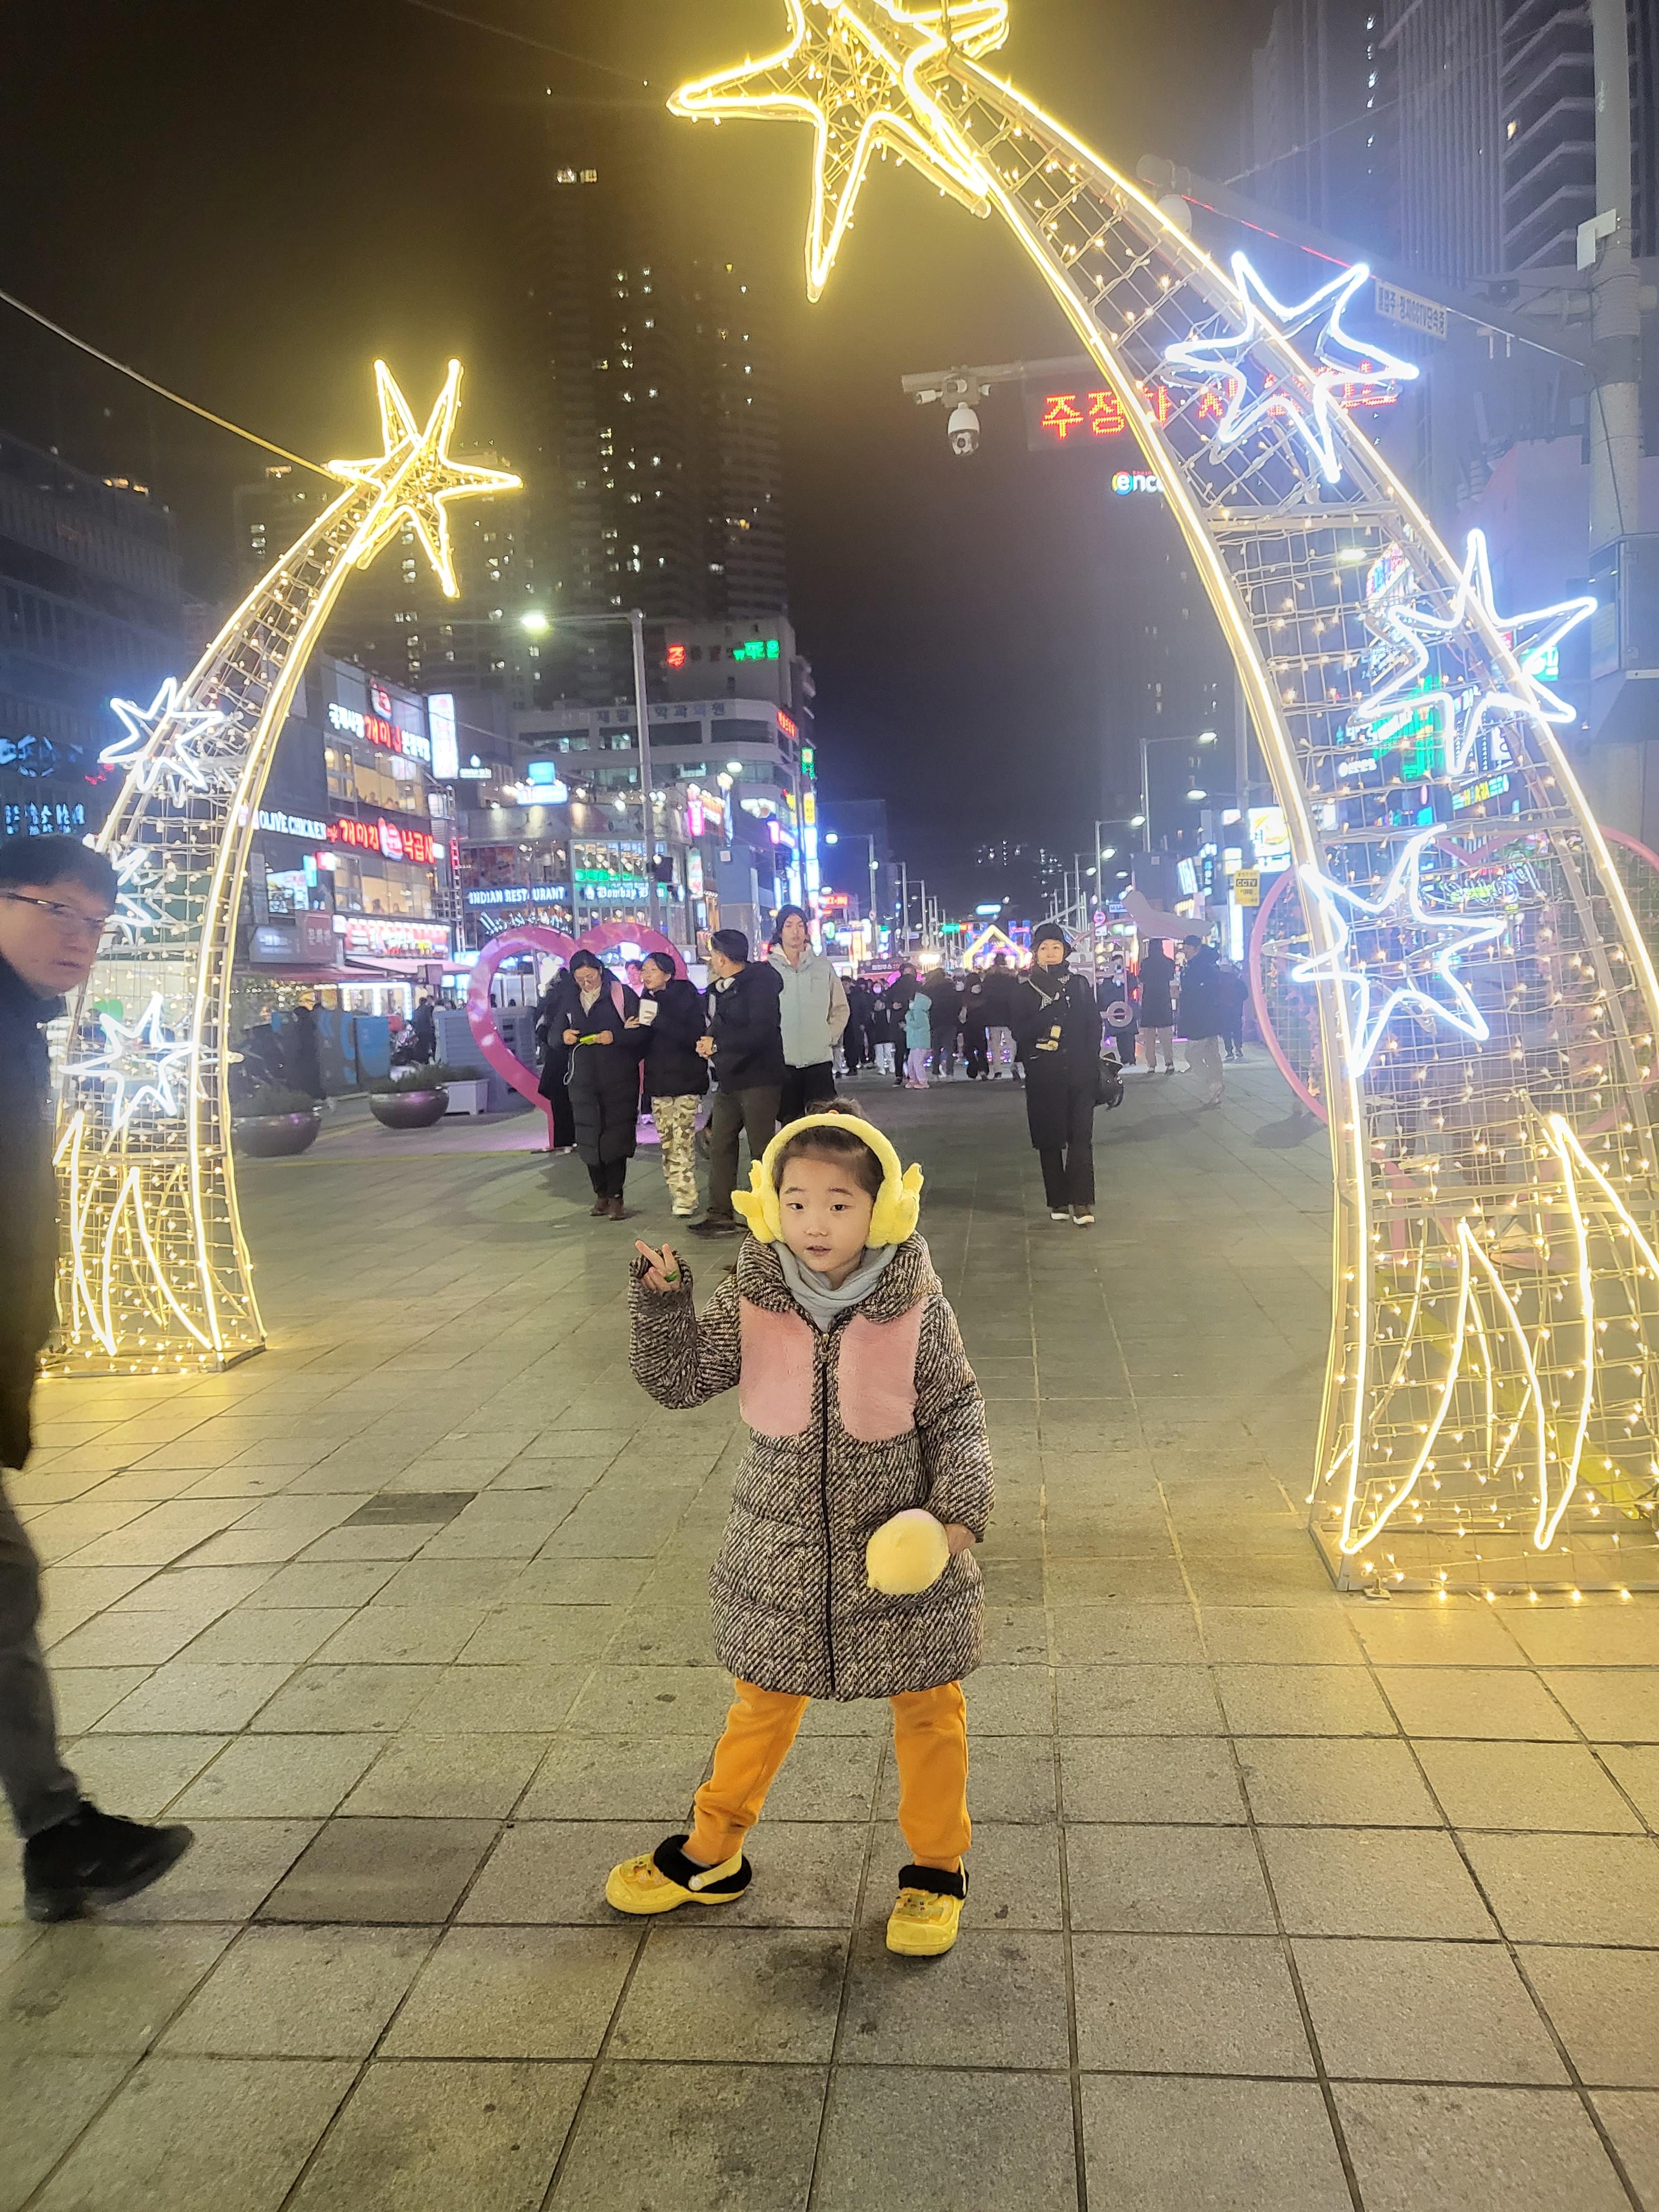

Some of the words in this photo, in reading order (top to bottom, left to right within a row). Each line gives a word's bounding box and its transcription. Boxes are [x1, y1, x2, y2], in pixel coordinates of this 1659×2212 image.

[337, 818, 379, 851] 개미집
[468, 889, 504, 905] INDIAN
[504, 886, 565, 902] RESTURANT
[596, 885, 637, 900] Bombay
